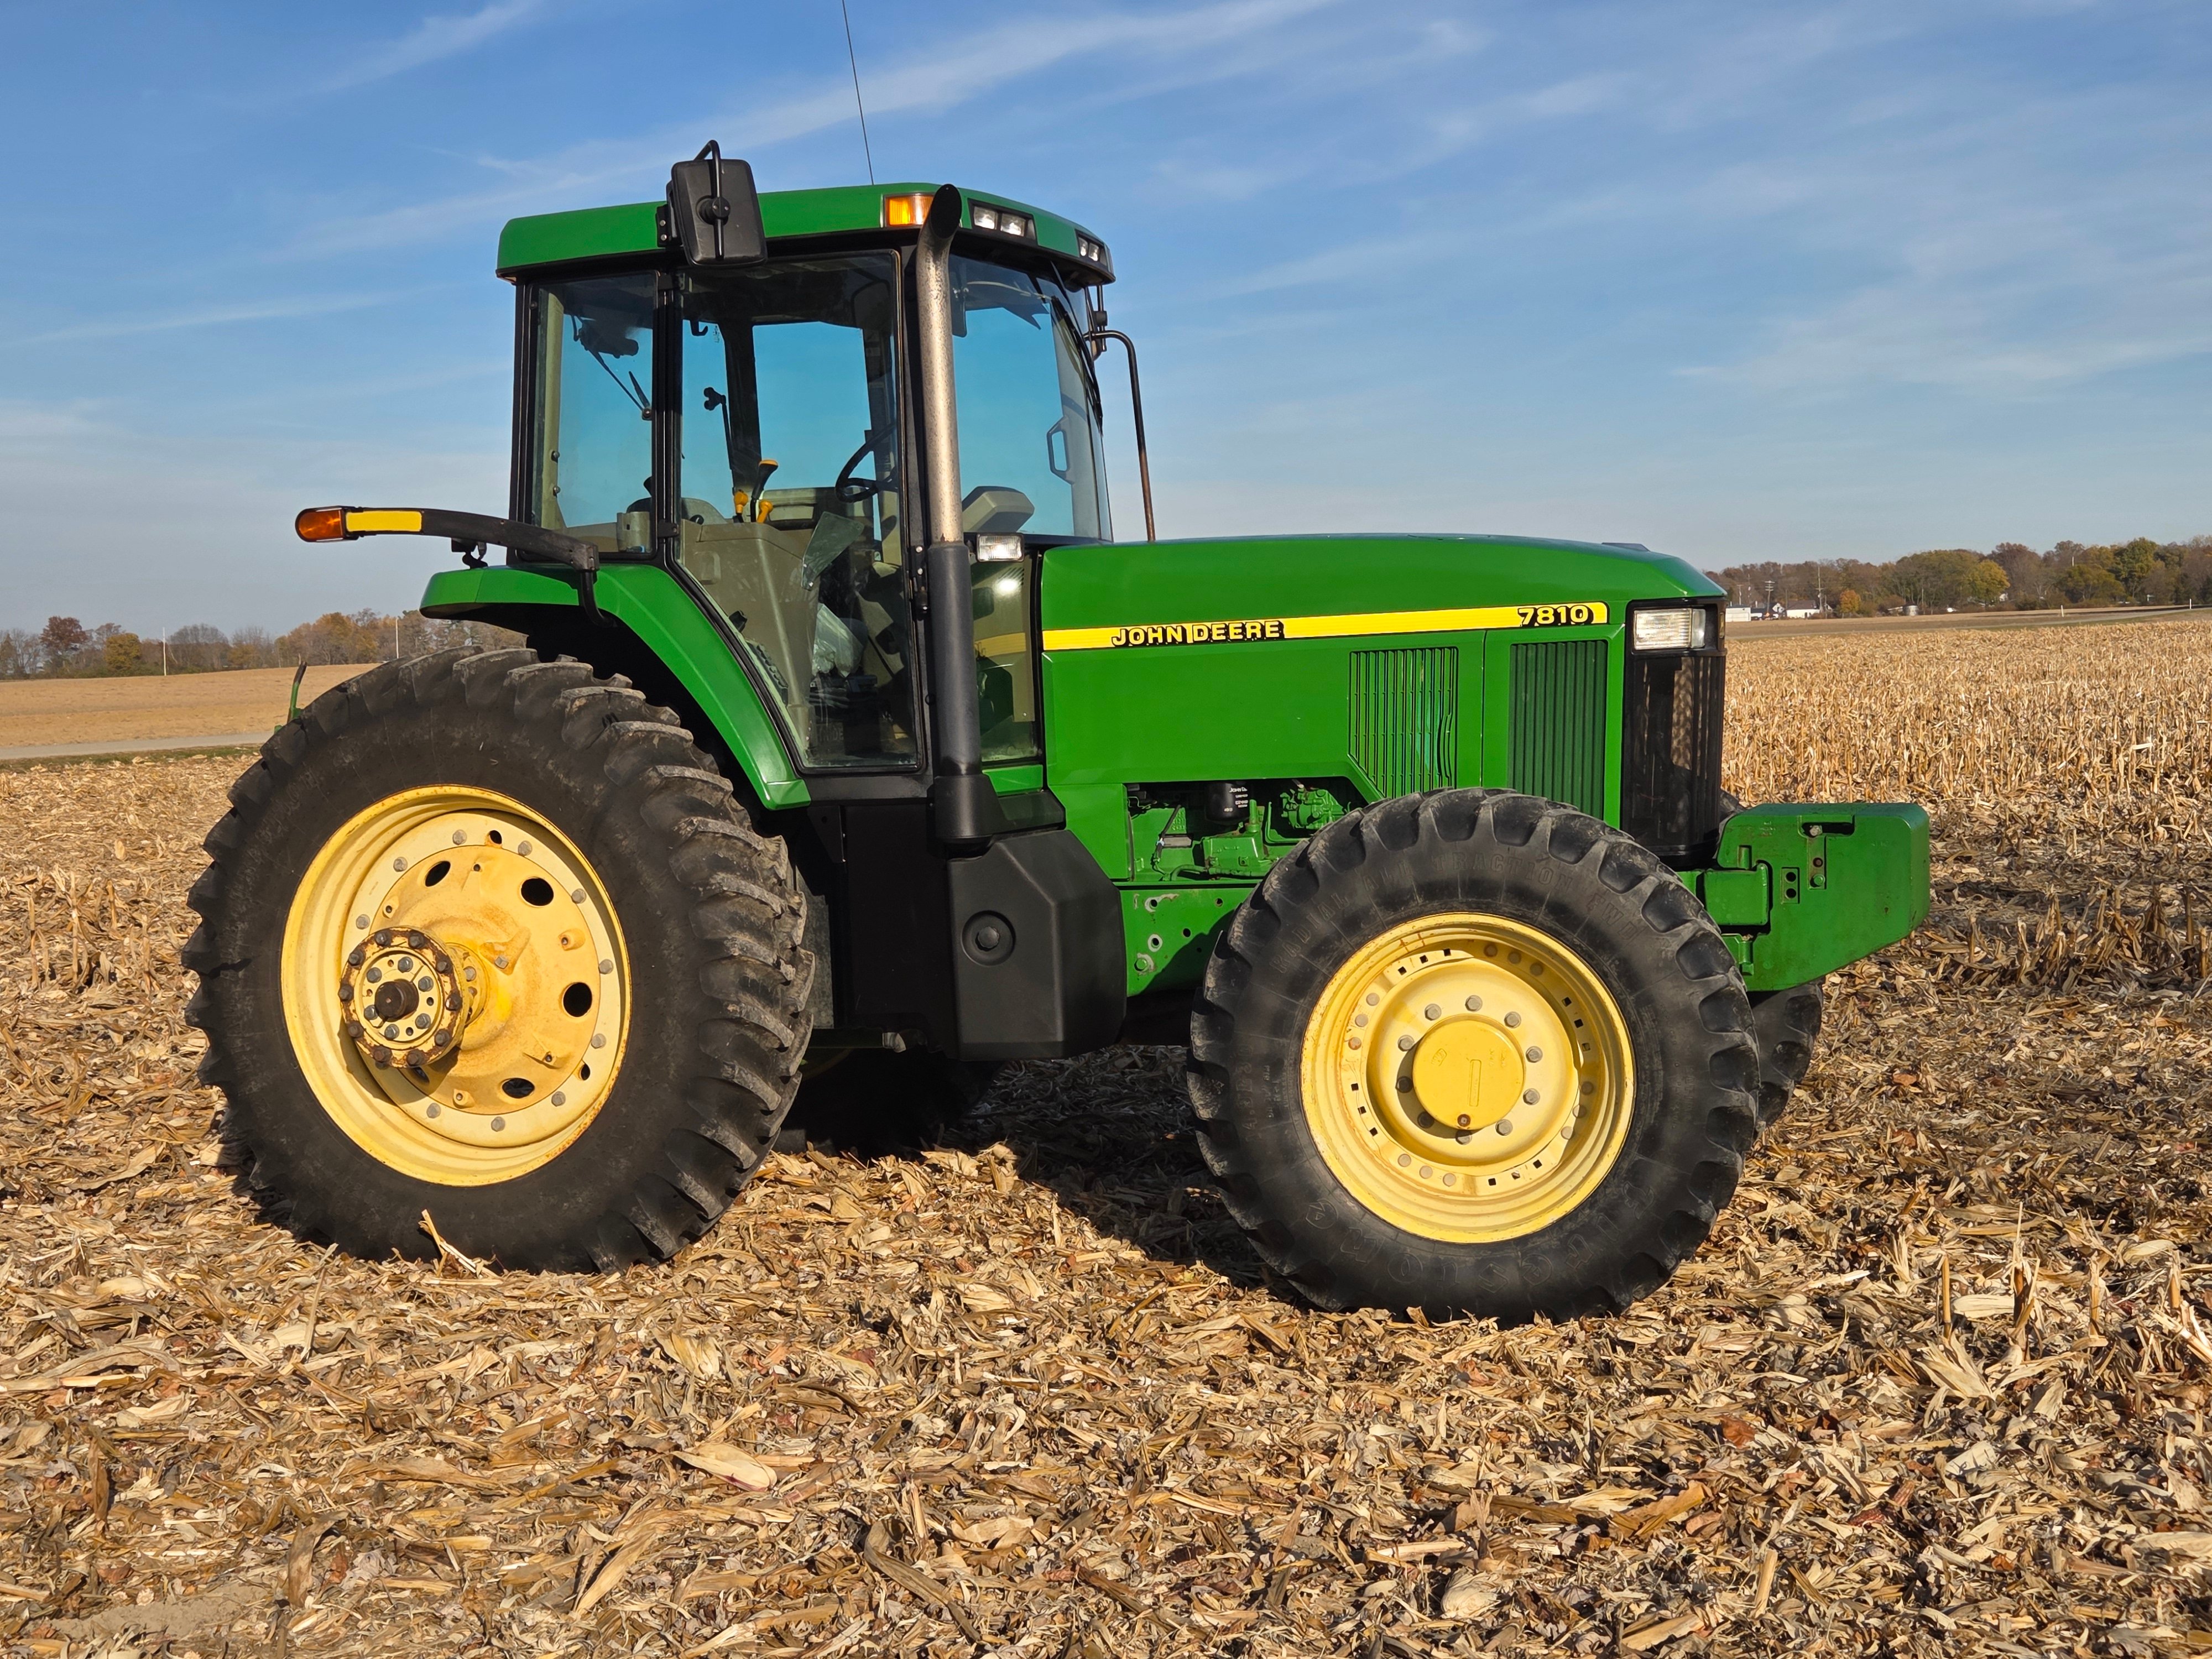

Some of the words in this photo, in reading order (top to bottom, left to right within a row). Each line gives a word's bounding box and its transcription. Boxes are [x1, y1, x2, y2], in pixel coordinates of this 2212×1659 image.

[1112, 625, 1188, 646] JOHN
[1192, 620, 1284, 643] DEERE
[1518, 604, 1593, 628] 7810
[1269, 893, 1349, 974] RADIAL
[1432, 852, 1573, 891] TRACTION
[1587, 893, 1638, 940] FWD
[1305, 1181, 1653, 1293] Firestone
